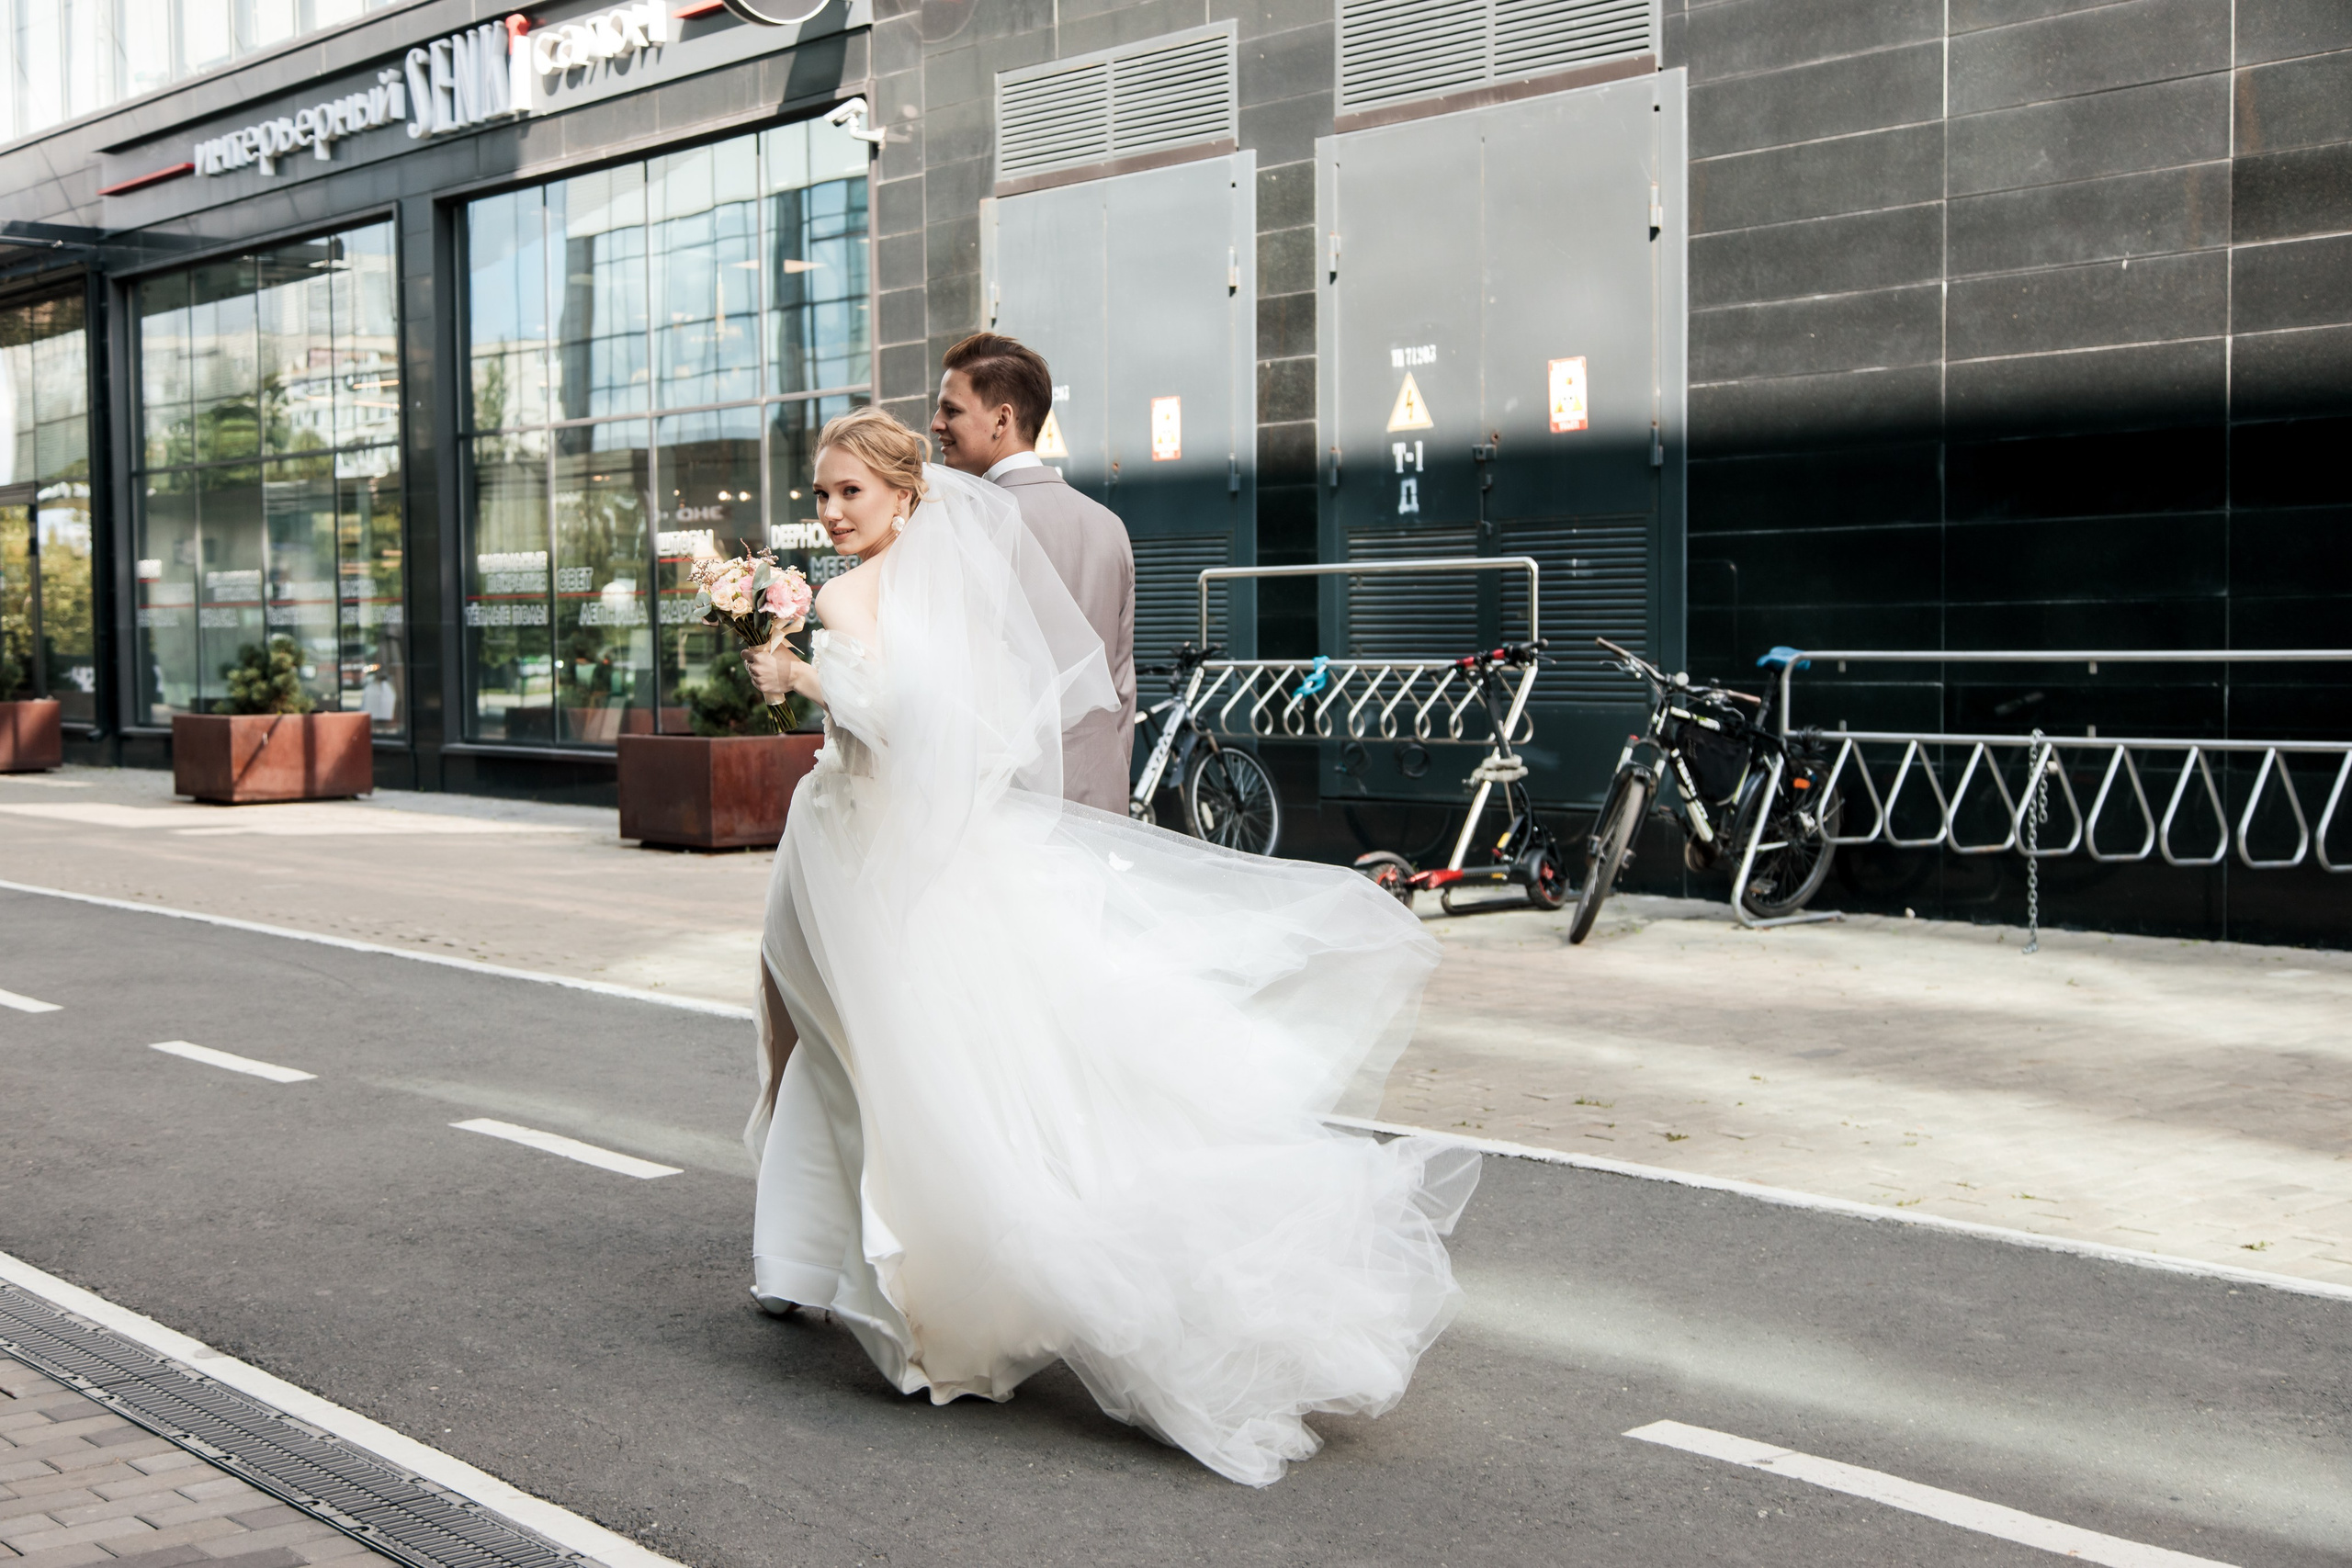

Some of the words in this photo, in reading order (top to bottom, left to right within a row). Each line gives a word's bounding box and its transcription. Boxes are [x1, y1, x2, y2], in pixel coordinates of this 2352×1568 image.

[195, 69, 405, 176] интерьерный
[534, 0, 668, 75] салон
[557, 567, 594, 592] СВЕТ
[579, 601, 649, 626] ЛЕПНИНА
